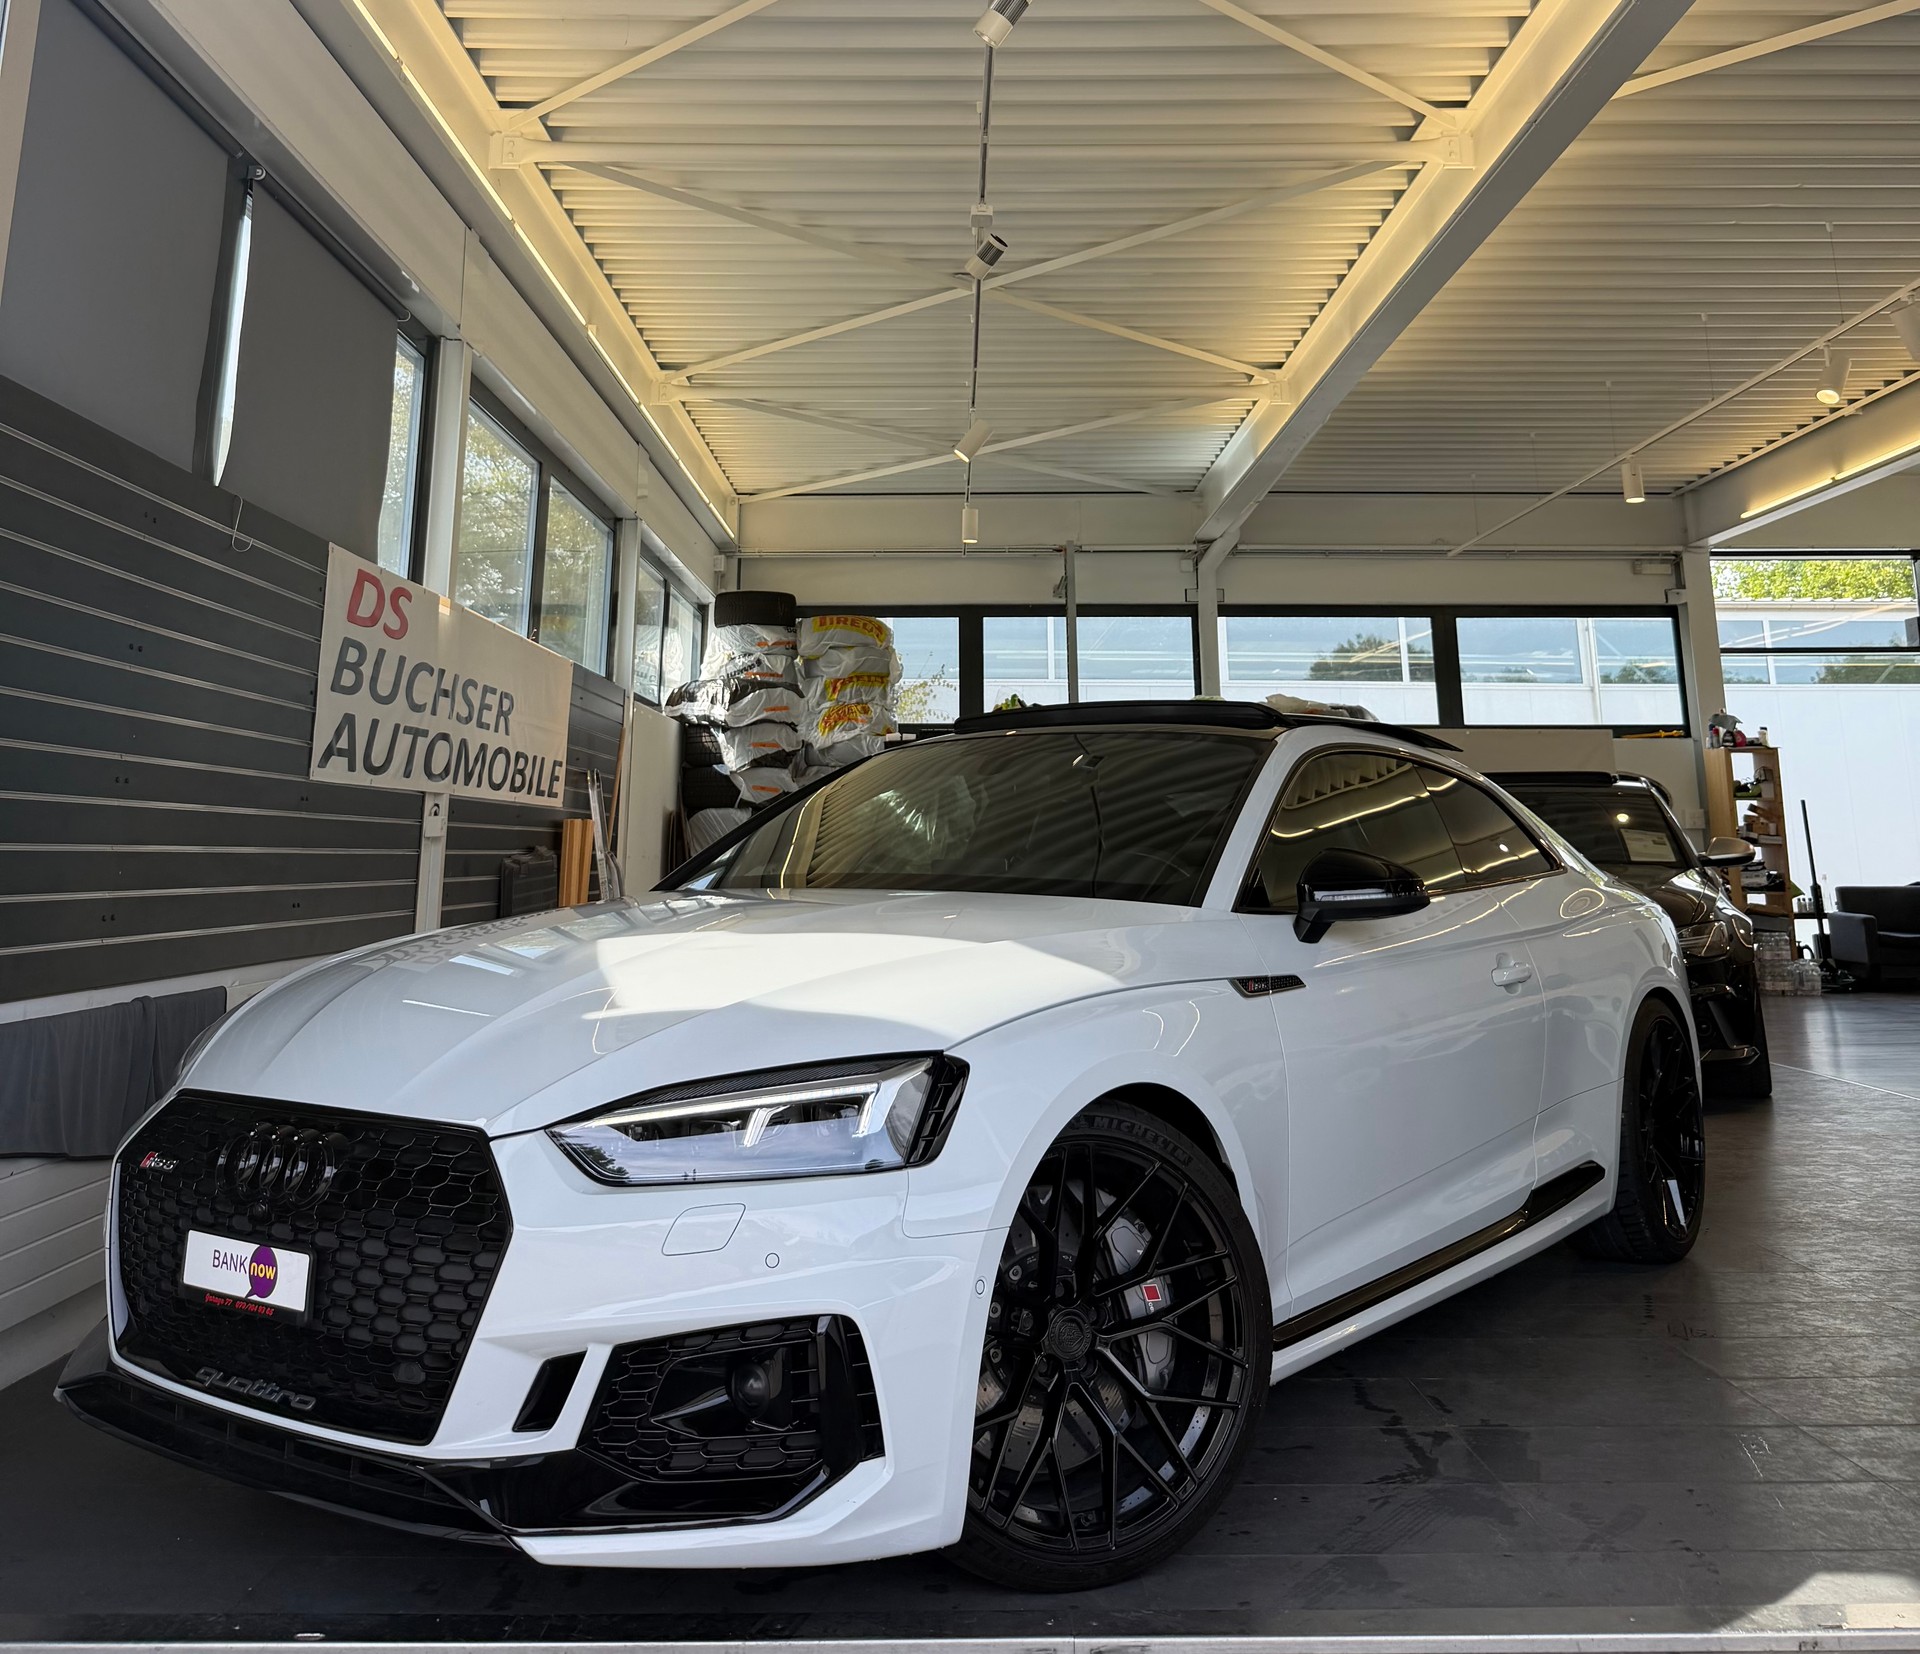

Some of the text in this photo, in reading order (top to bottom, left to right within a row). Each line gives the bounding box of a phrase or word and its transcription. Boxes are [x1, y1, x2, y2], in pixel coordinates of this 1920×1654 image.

[346, 568, 413, 640] DS
[330, 636, 515, 736] BUCHSER
[317, 712, 563, 798] AUTOMOBILE
[1093, 1116, 1193, 1166] MICHELIN
[212, 1249, 277, 1280] BANK now
[195, 1366, 317, 1411] quattro
